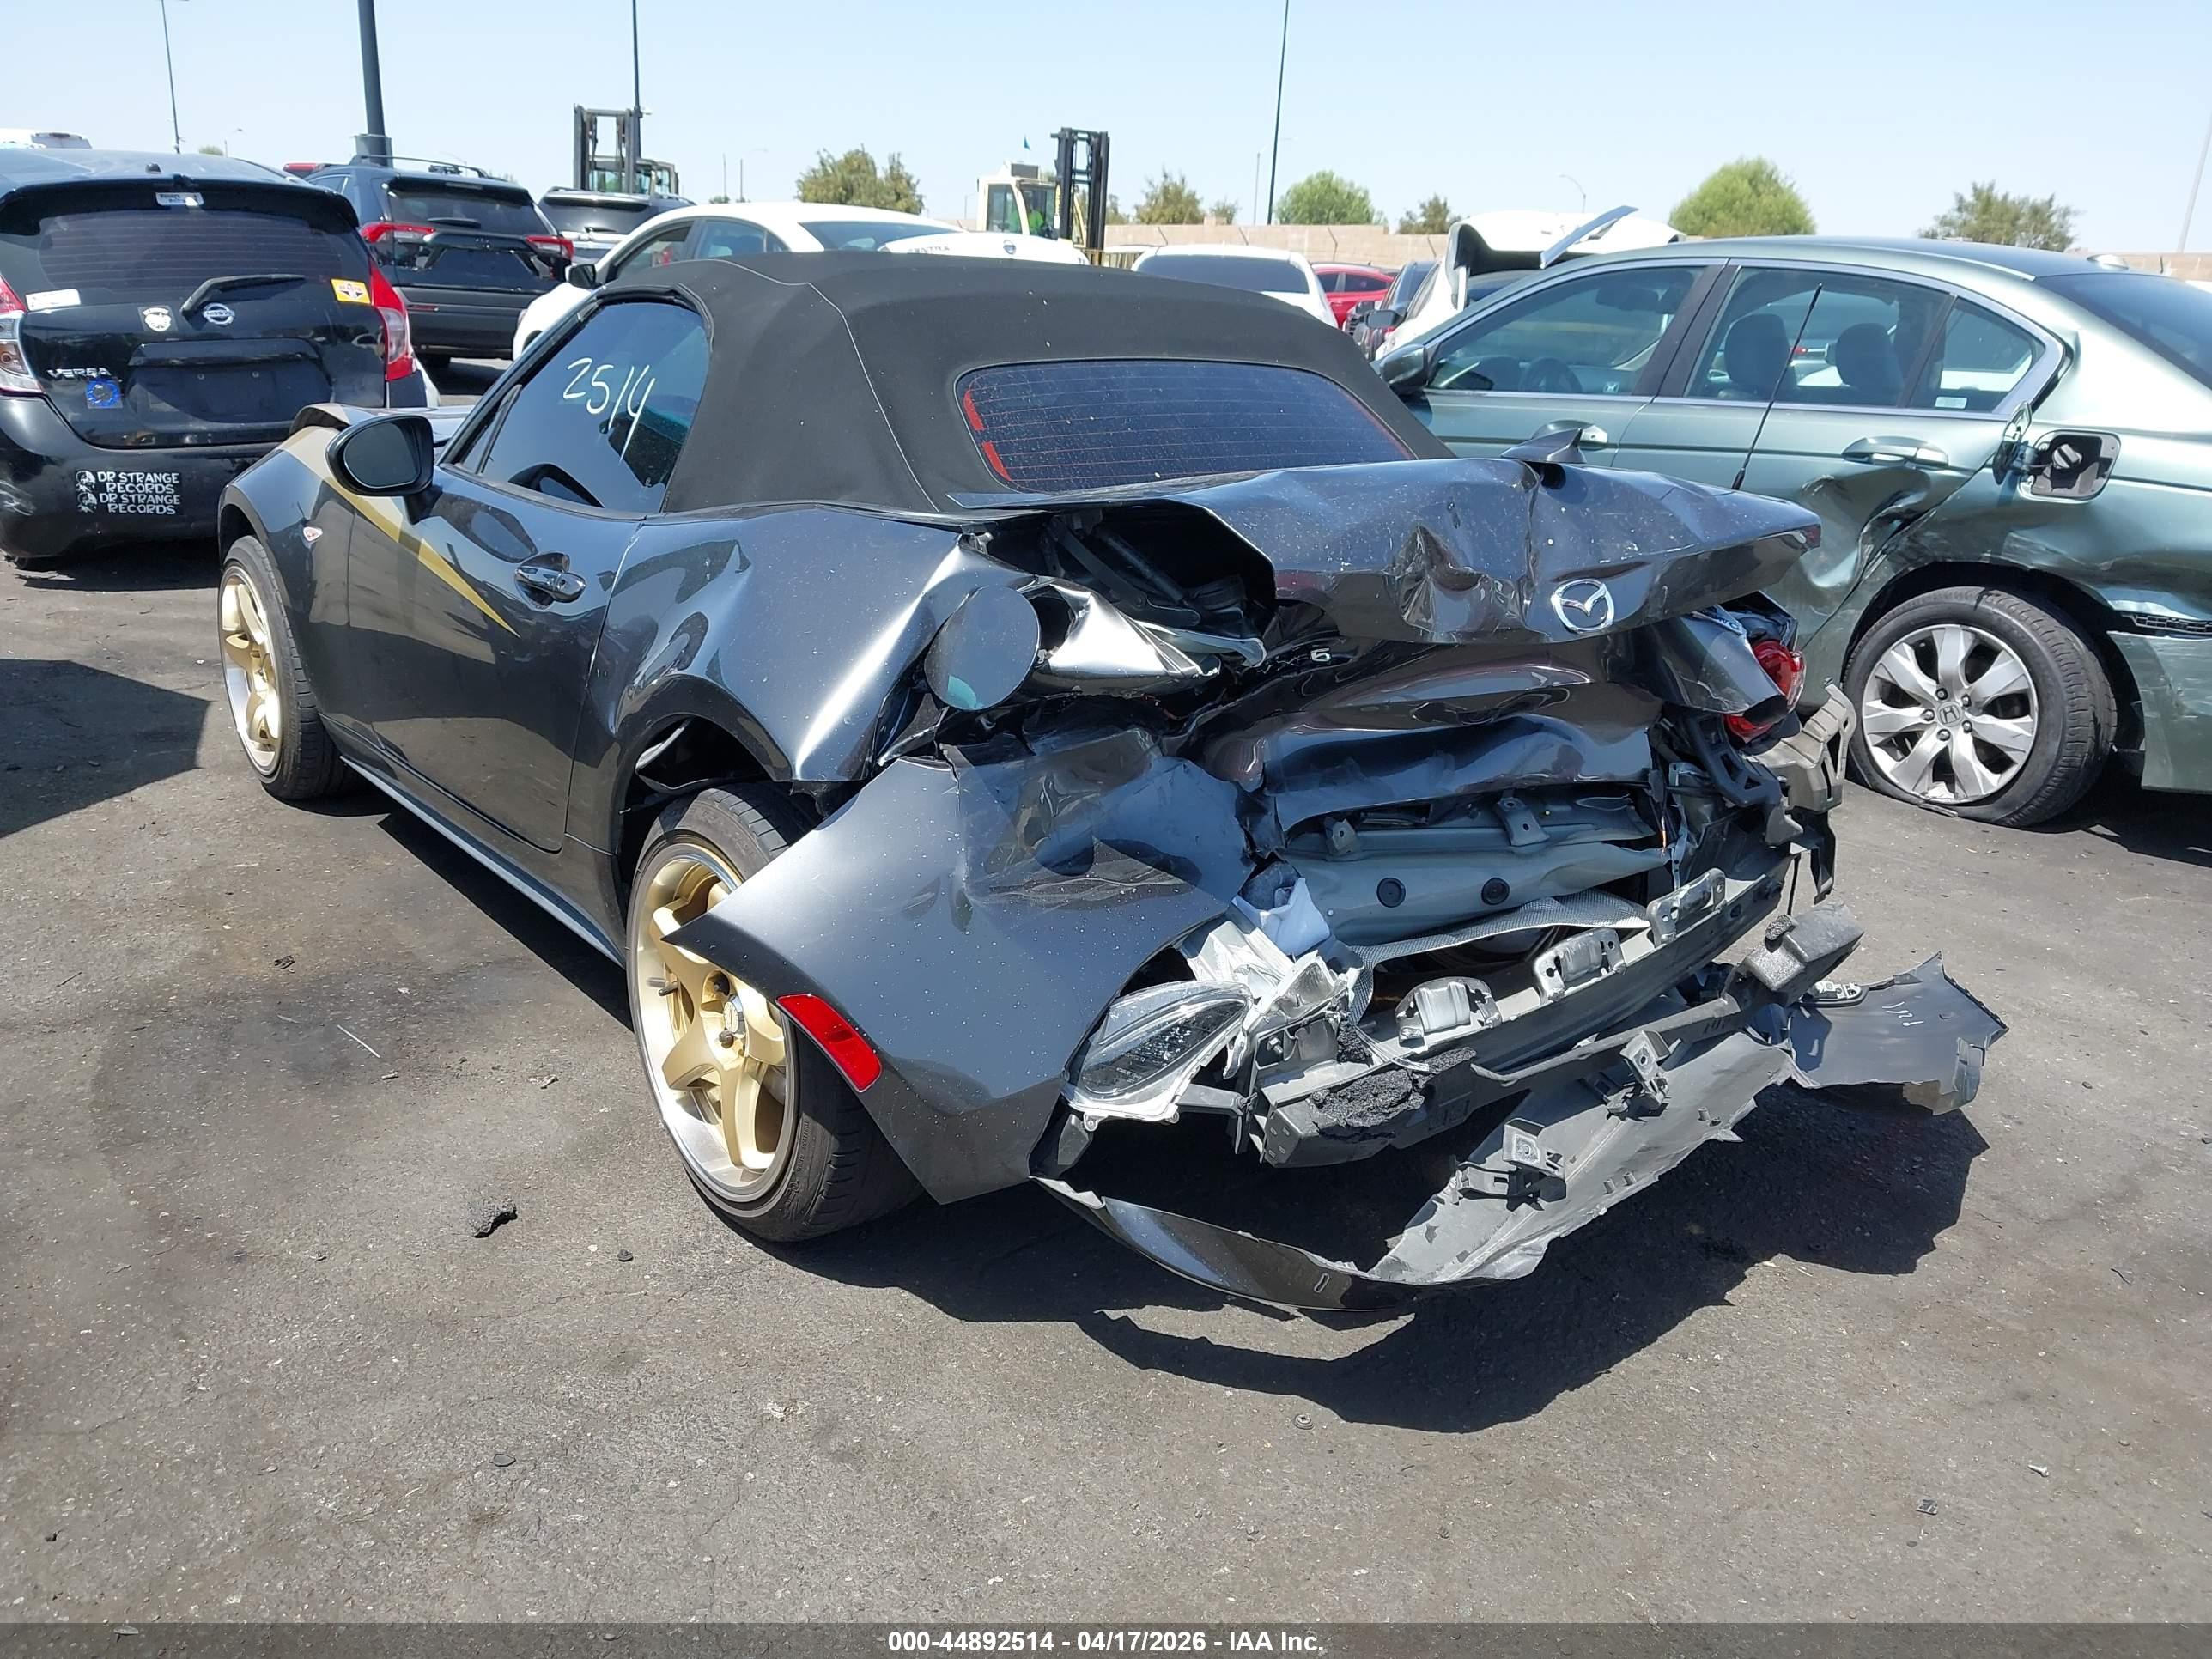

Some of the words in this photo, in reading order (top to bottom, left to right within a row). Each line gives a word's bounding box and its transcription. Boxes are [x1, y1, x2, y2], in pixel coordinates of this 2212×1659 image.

[97, 471, 116, 482] DR
[118, 472, 179, 483] STRANGE
[106, 482, 174, 494] RECORDS
[99, 493, 118, 503] DR
[121, 493, 180, 505] STRANGE
[107, 503, 175, 515] RECORDS
